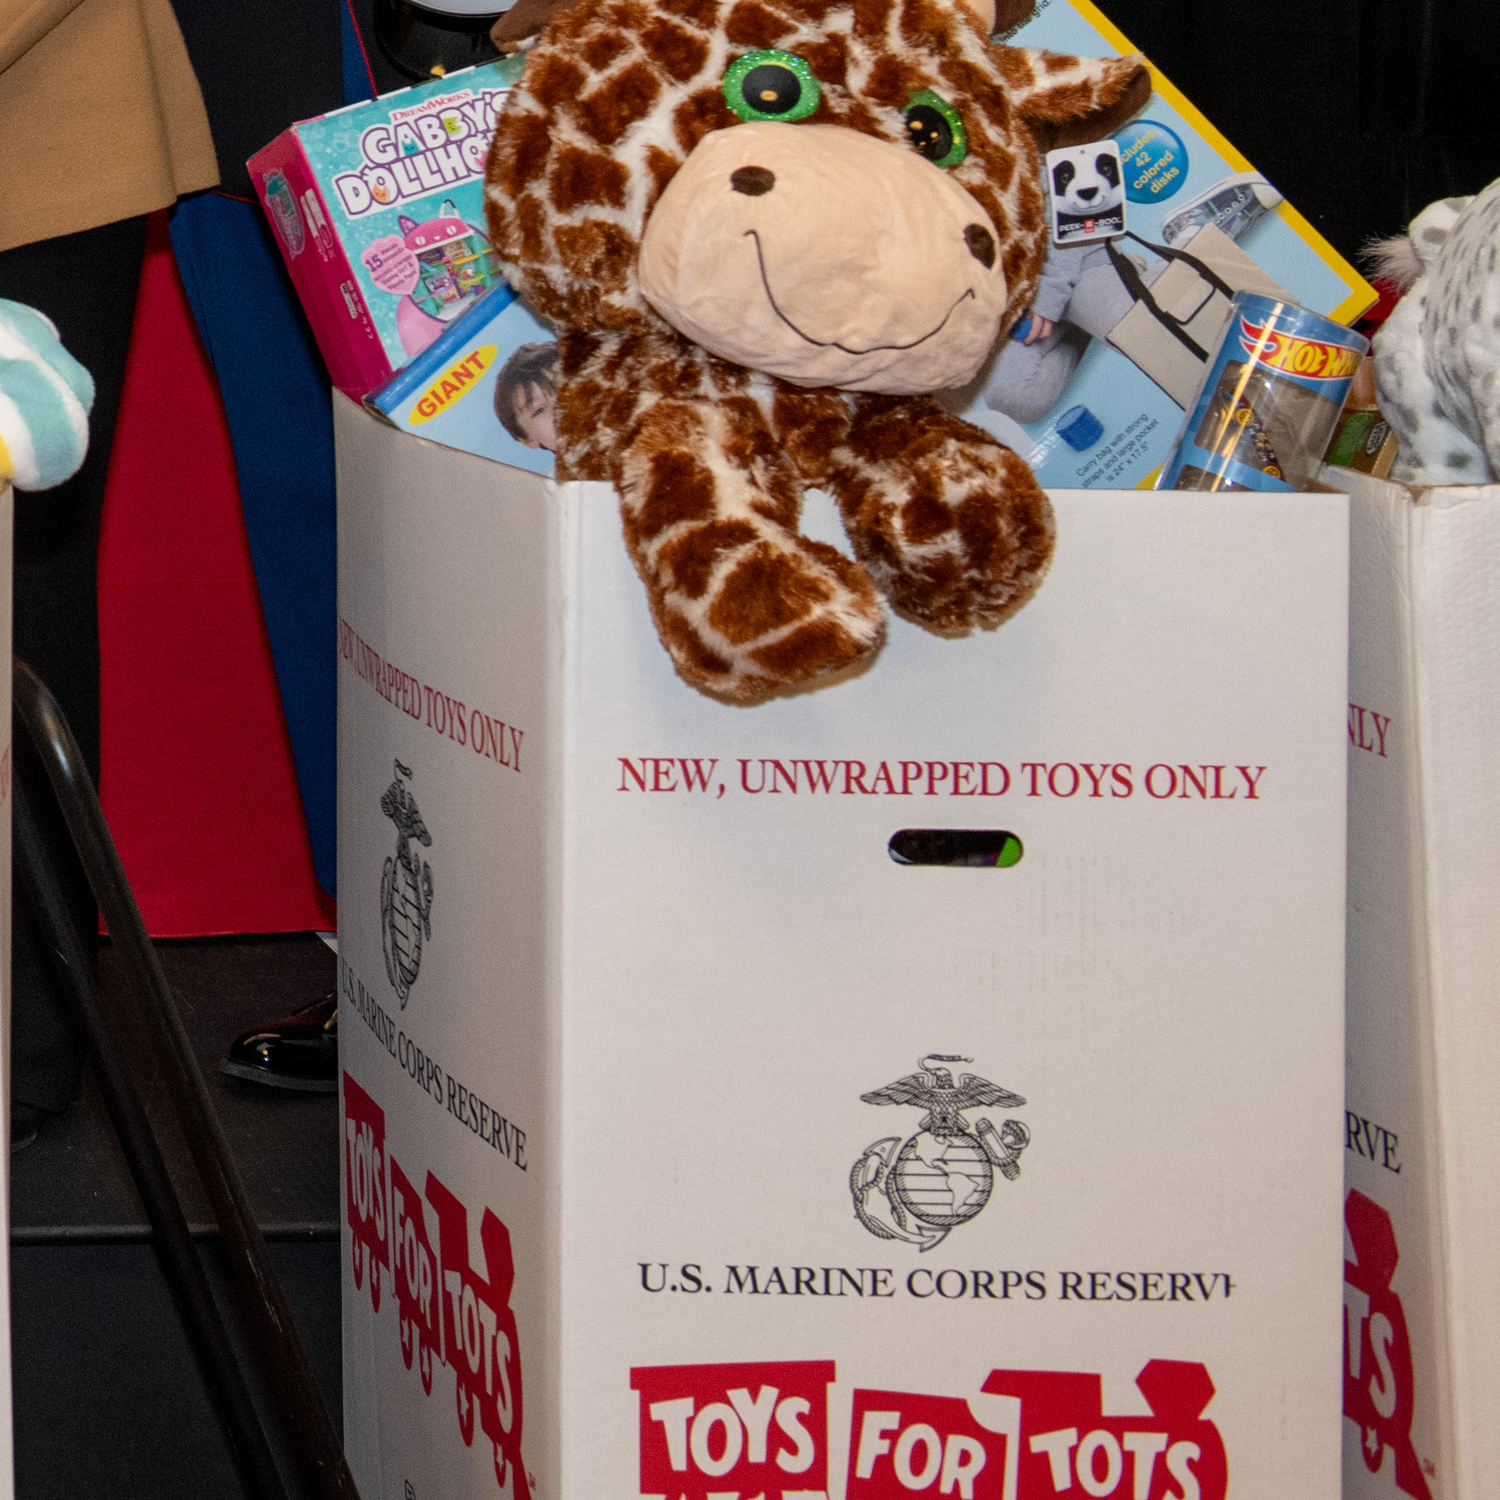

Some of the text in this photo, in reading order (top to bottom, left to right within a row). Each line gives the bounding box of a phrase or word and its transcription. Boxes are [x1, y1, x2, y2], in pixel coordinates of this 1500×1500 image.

[335, 135, 493, 216] DOLLHO
[1120, 130, 1157, 163] cludes
[1133, 150, 1175, 189] colored
[1135, 151, 1152, 167] 42
[1150, 166, 1180, 194] disks
[365, 254, 384, 272] 15
[417, 350, 485, 417] GIANT
[1076, 413, 1149, 477] Carry bag with strong
[1082, 418, 1160, 489] straps and large pocket
[424, 684, 467, 746] TOYS
[471, 709, 524, 773] ONLY
[616, 757, 1268, 800] NEW, UNWRAPPED TOYS ONLY
[398, 1030, 443, 1105] CORPS
[445, 1072, 528, 1172] RESERVE
[346, 1118, 514, 1435] TOYS FOR TOTS
[637, 1262, 712, 1295] U.S.
[724, 1264, 896, 1298] MARINE
[905, 1268, 1046, 1300] CORPS
[649, 1384, 1202, 1500] TOYS FOR TOTS
